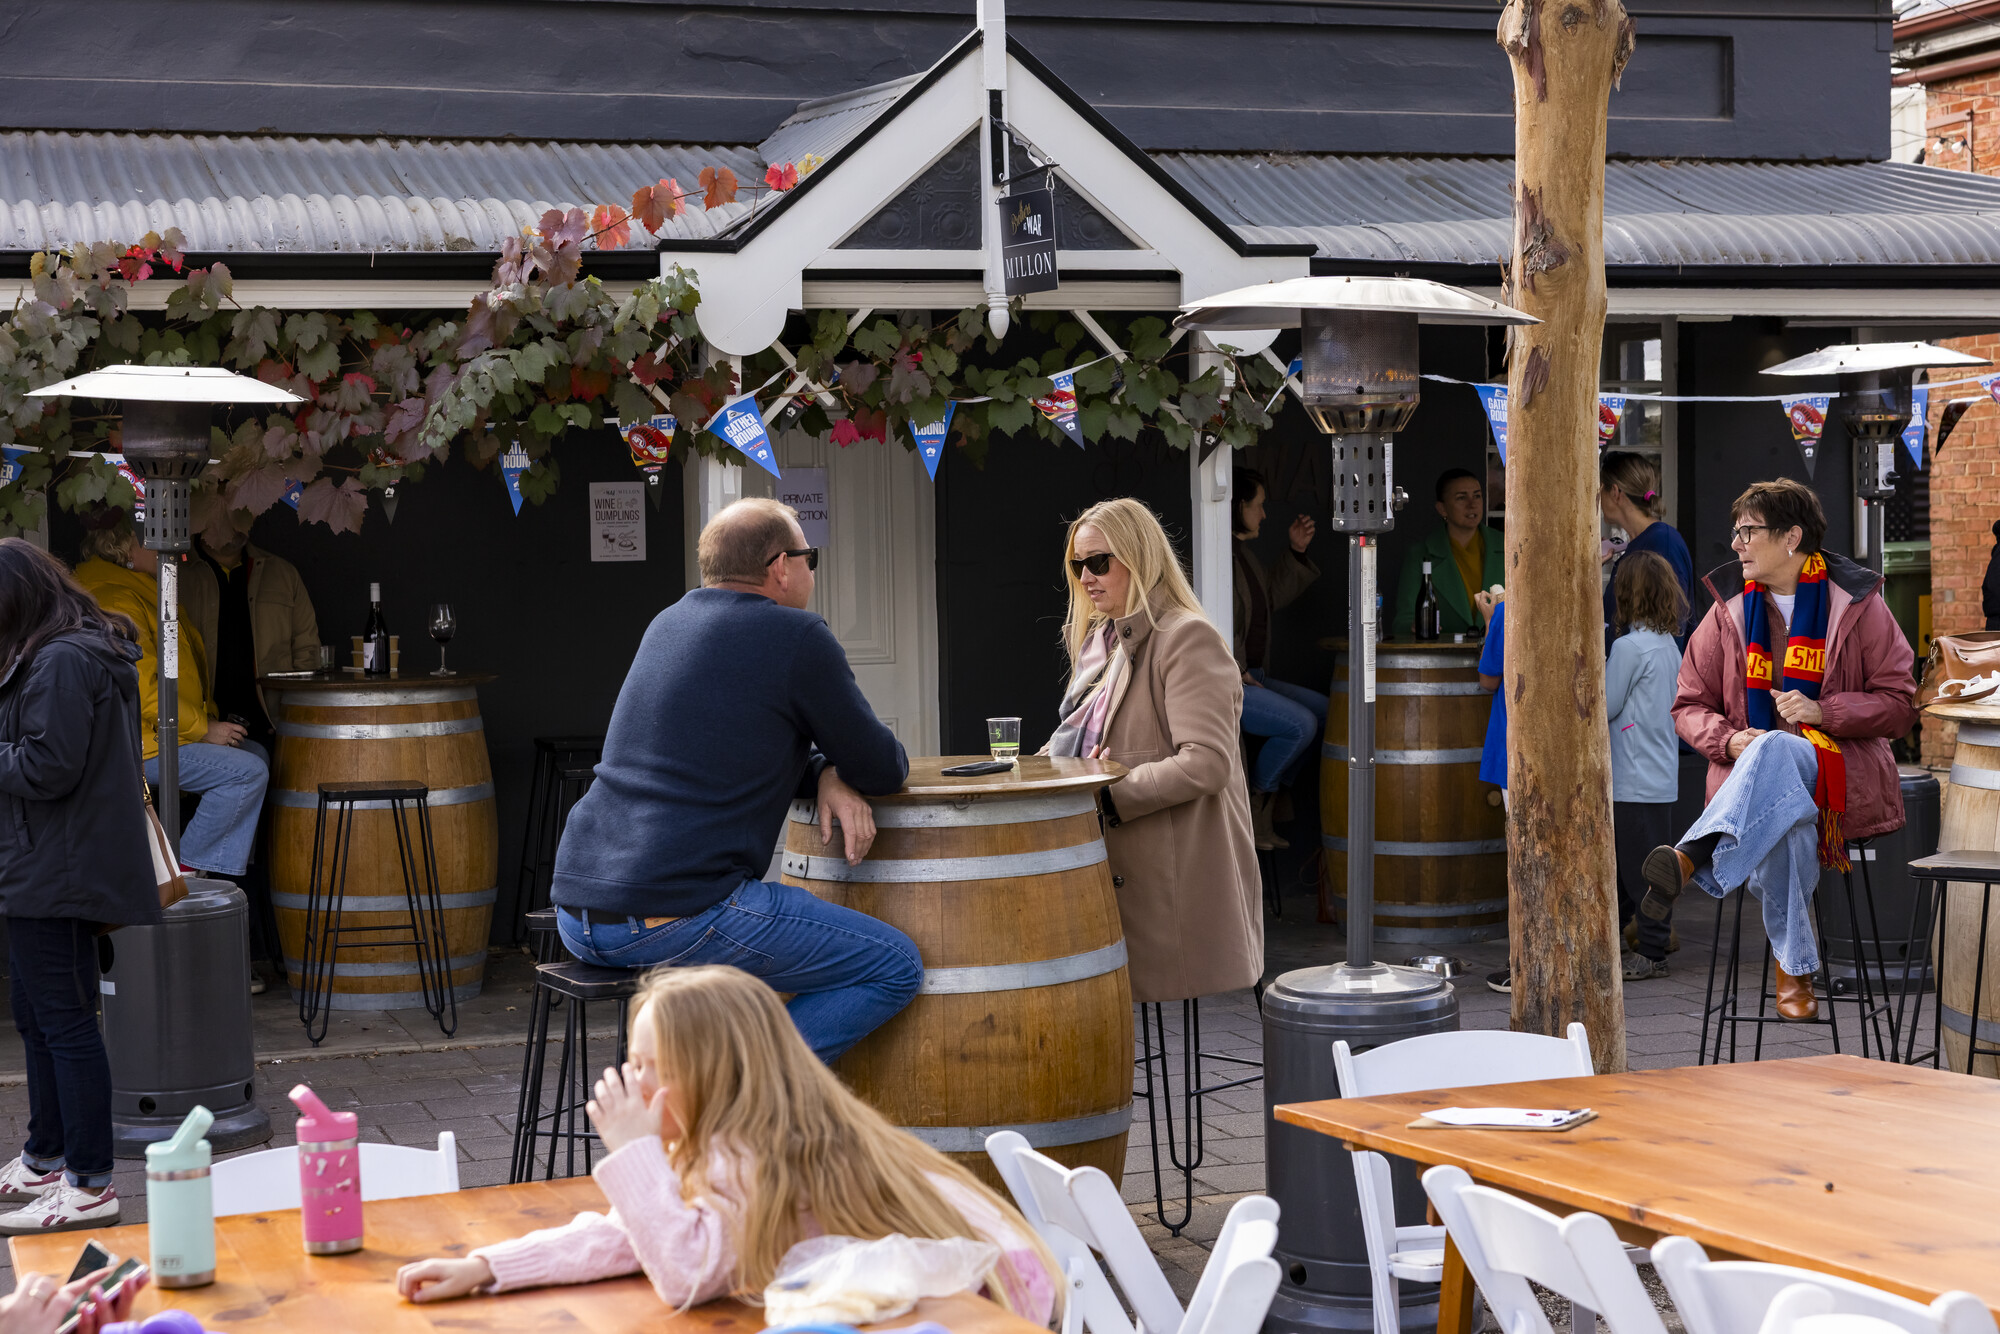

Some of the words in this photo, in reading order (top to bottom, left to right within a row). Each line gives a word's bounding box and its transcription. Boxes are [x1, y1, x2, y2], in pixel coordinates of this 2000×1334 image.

[1026, 214, 1042, 236] WAR
[1005, 251, 1052, 280] MILLON
[723, 412, 758, 439] GATHER
[732, 423, 765, 448] ROUND
[594, 498, 615, 509] WINE
[783, 493, 823, 504] PRIVATE
[595, 510, 640, 521] DUMPLINGS
[797, 510, 828, 521] CTION
